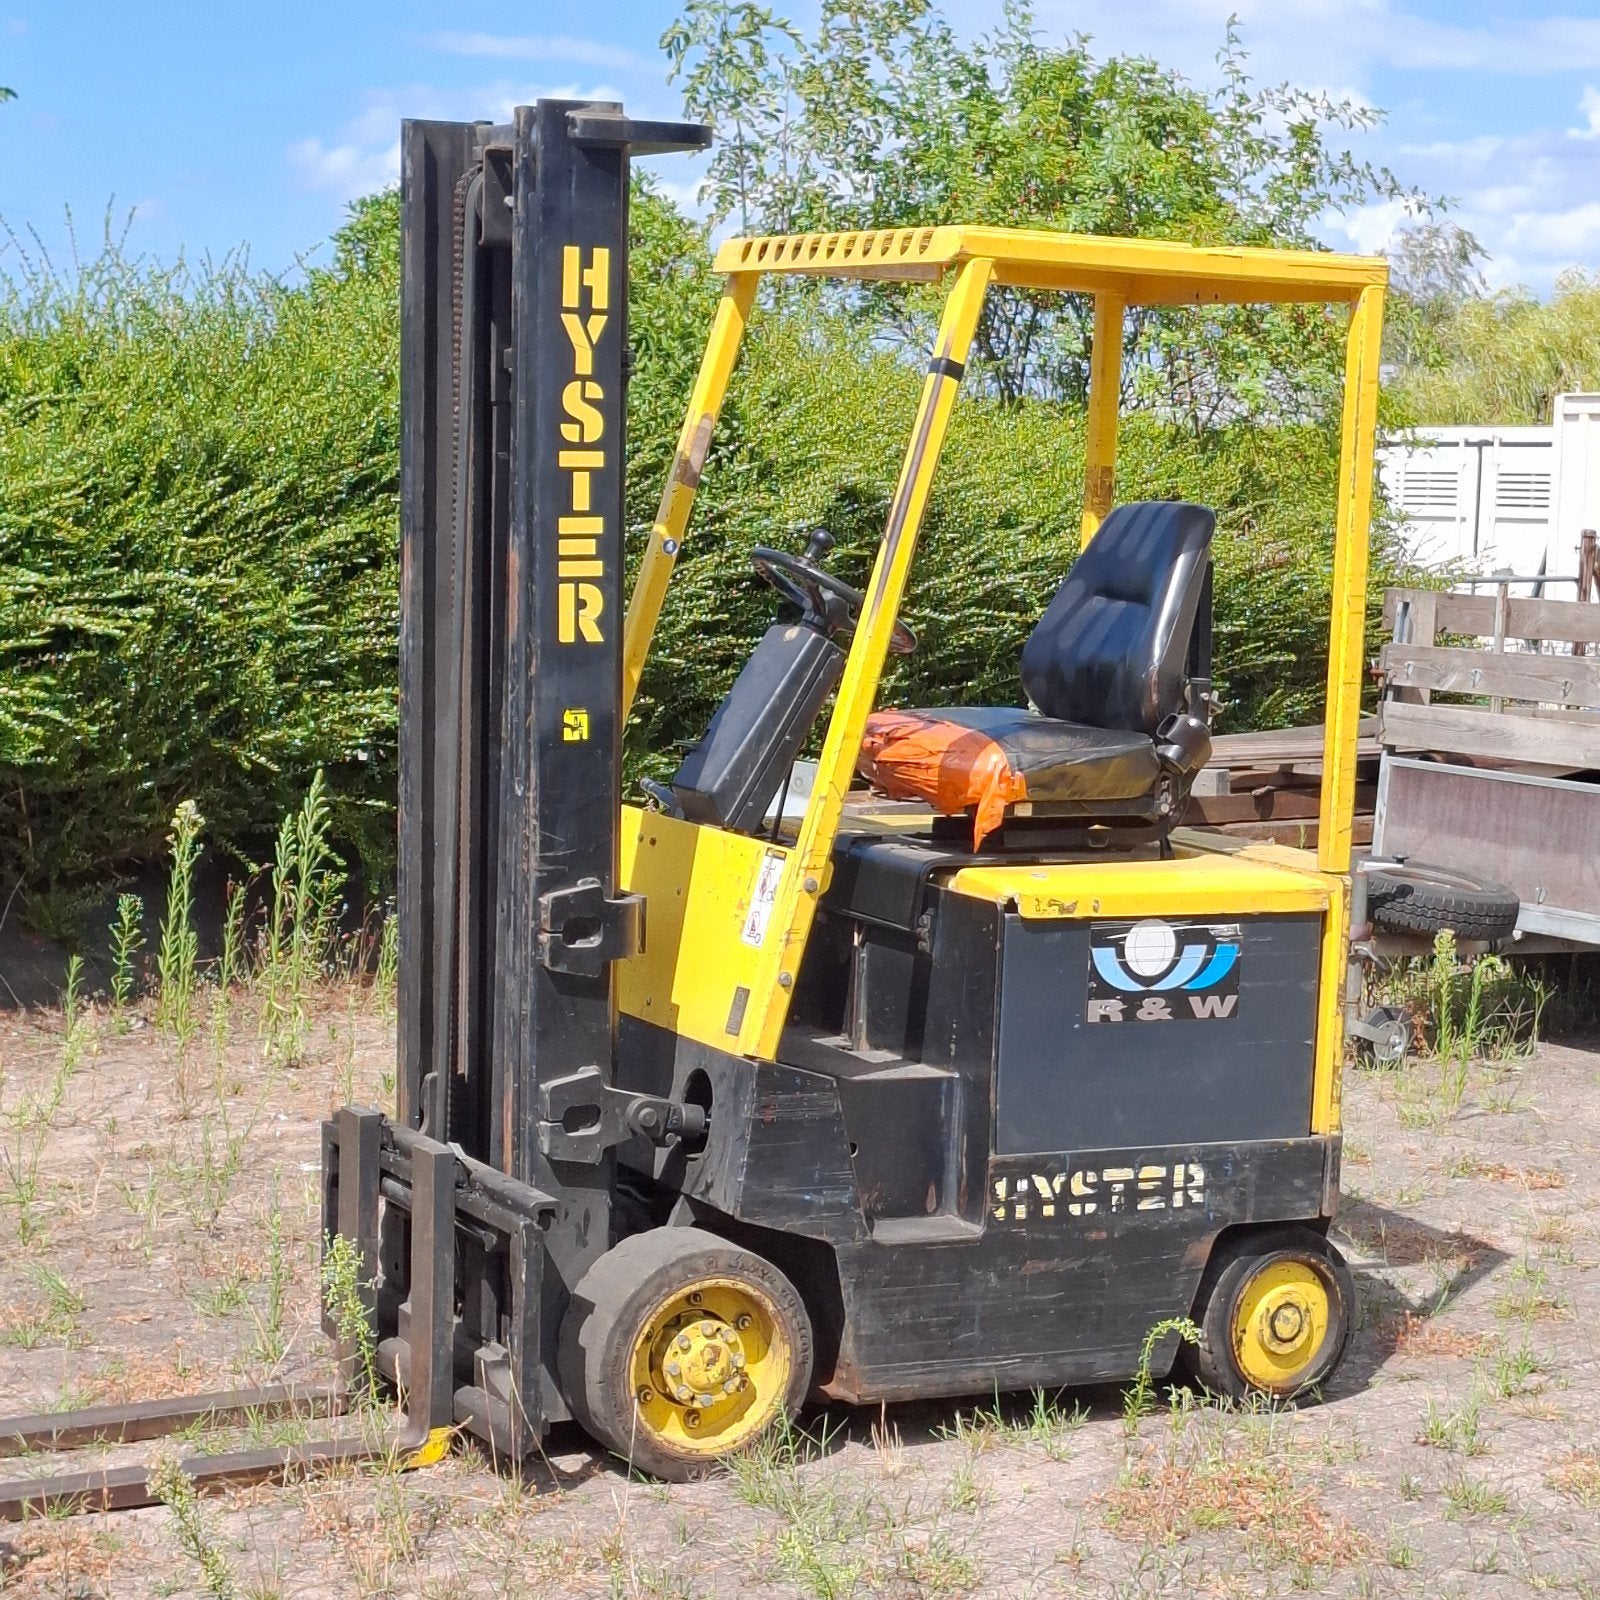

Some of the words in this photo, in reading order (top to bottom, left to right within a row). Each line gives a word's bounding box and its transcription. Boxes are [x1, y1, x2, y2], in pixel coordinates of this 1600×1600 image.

[558, 246, 609, 643] HYSTER
[1087, 999, 1126, 1023] R
[1136, 997, 1175, 1021] &
[1188, 994, 1238, 1019] W
[993, 1164, 1205, 1221] HYSTER
